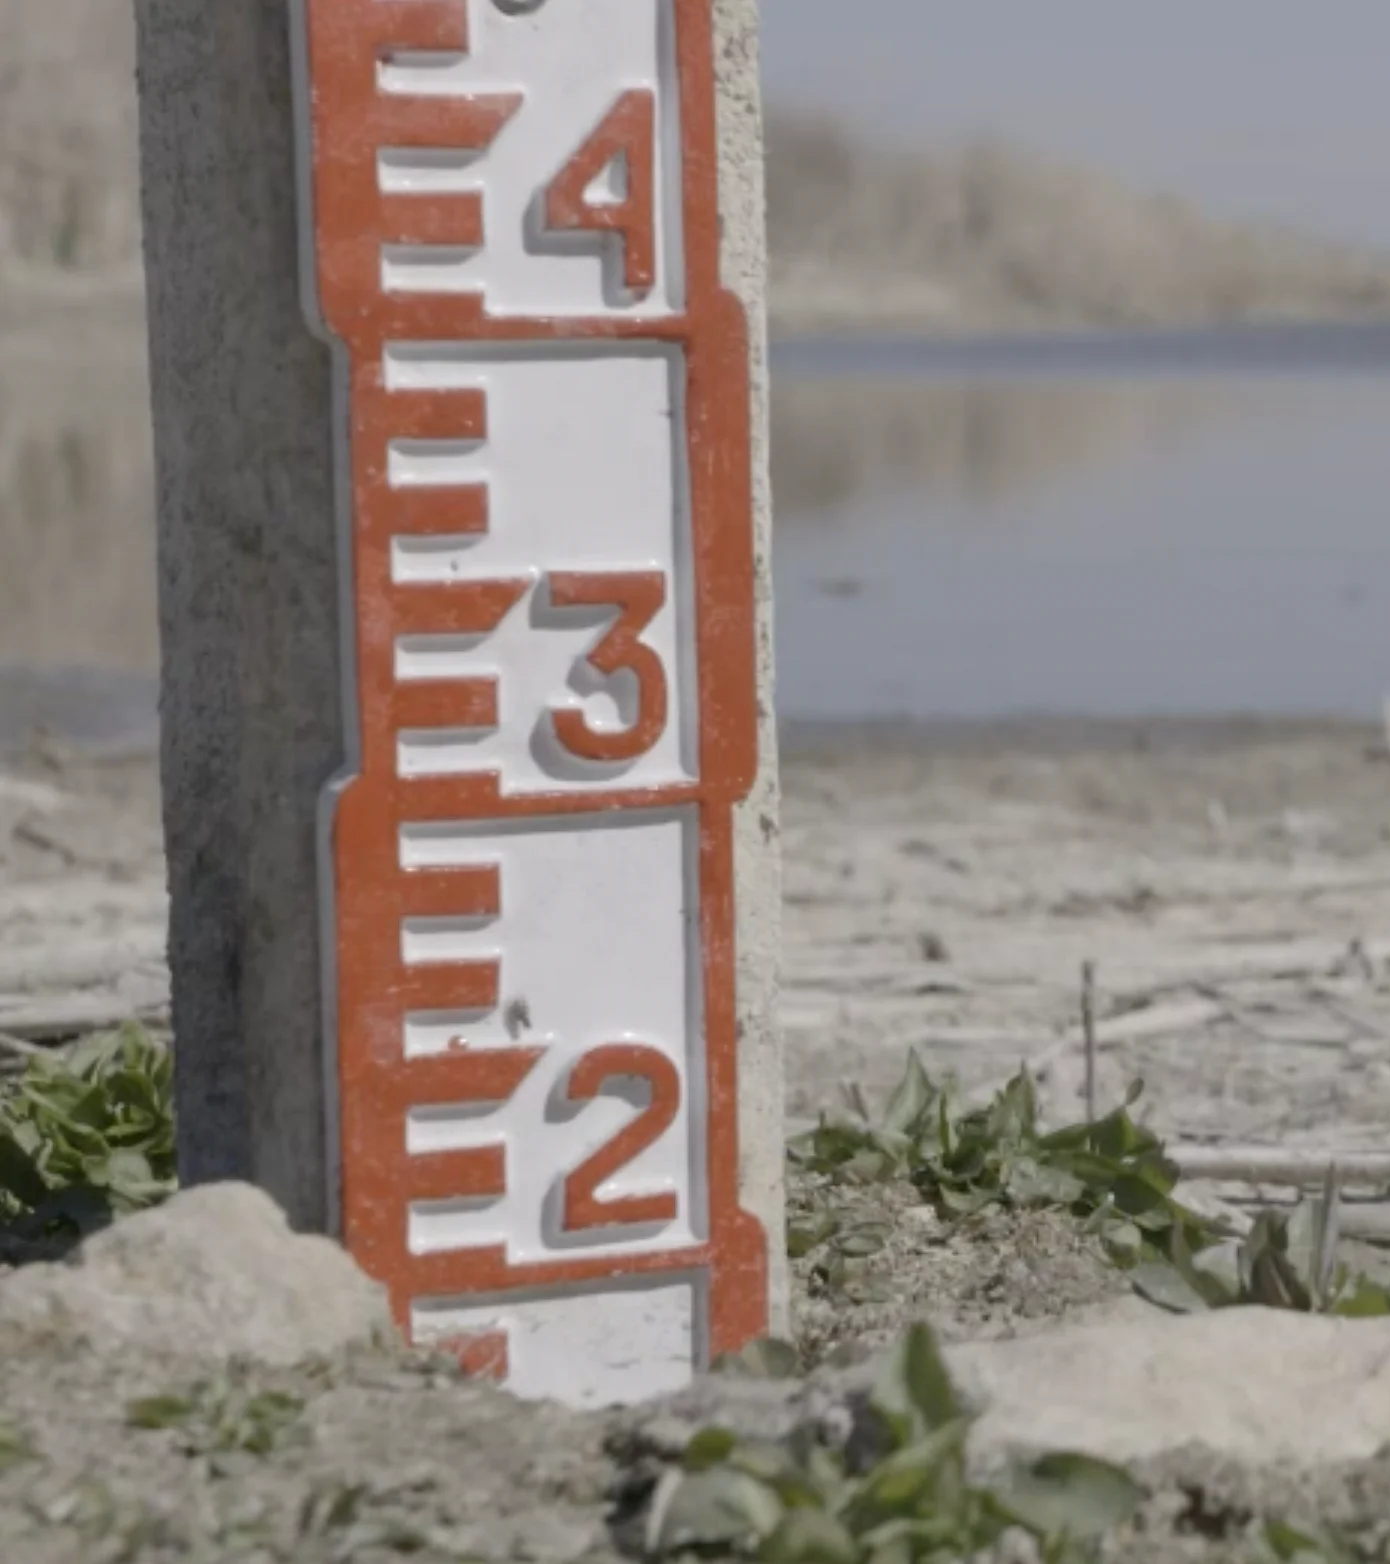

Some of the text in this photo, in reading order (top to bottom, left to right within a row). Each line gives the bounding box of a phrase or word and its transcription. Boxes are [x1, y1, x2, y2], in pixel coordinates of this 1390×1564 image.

[545, 88, 655, 289] 4
[548, 571, 668, 760] 3
[562, 1042, 681, 1231] 2
